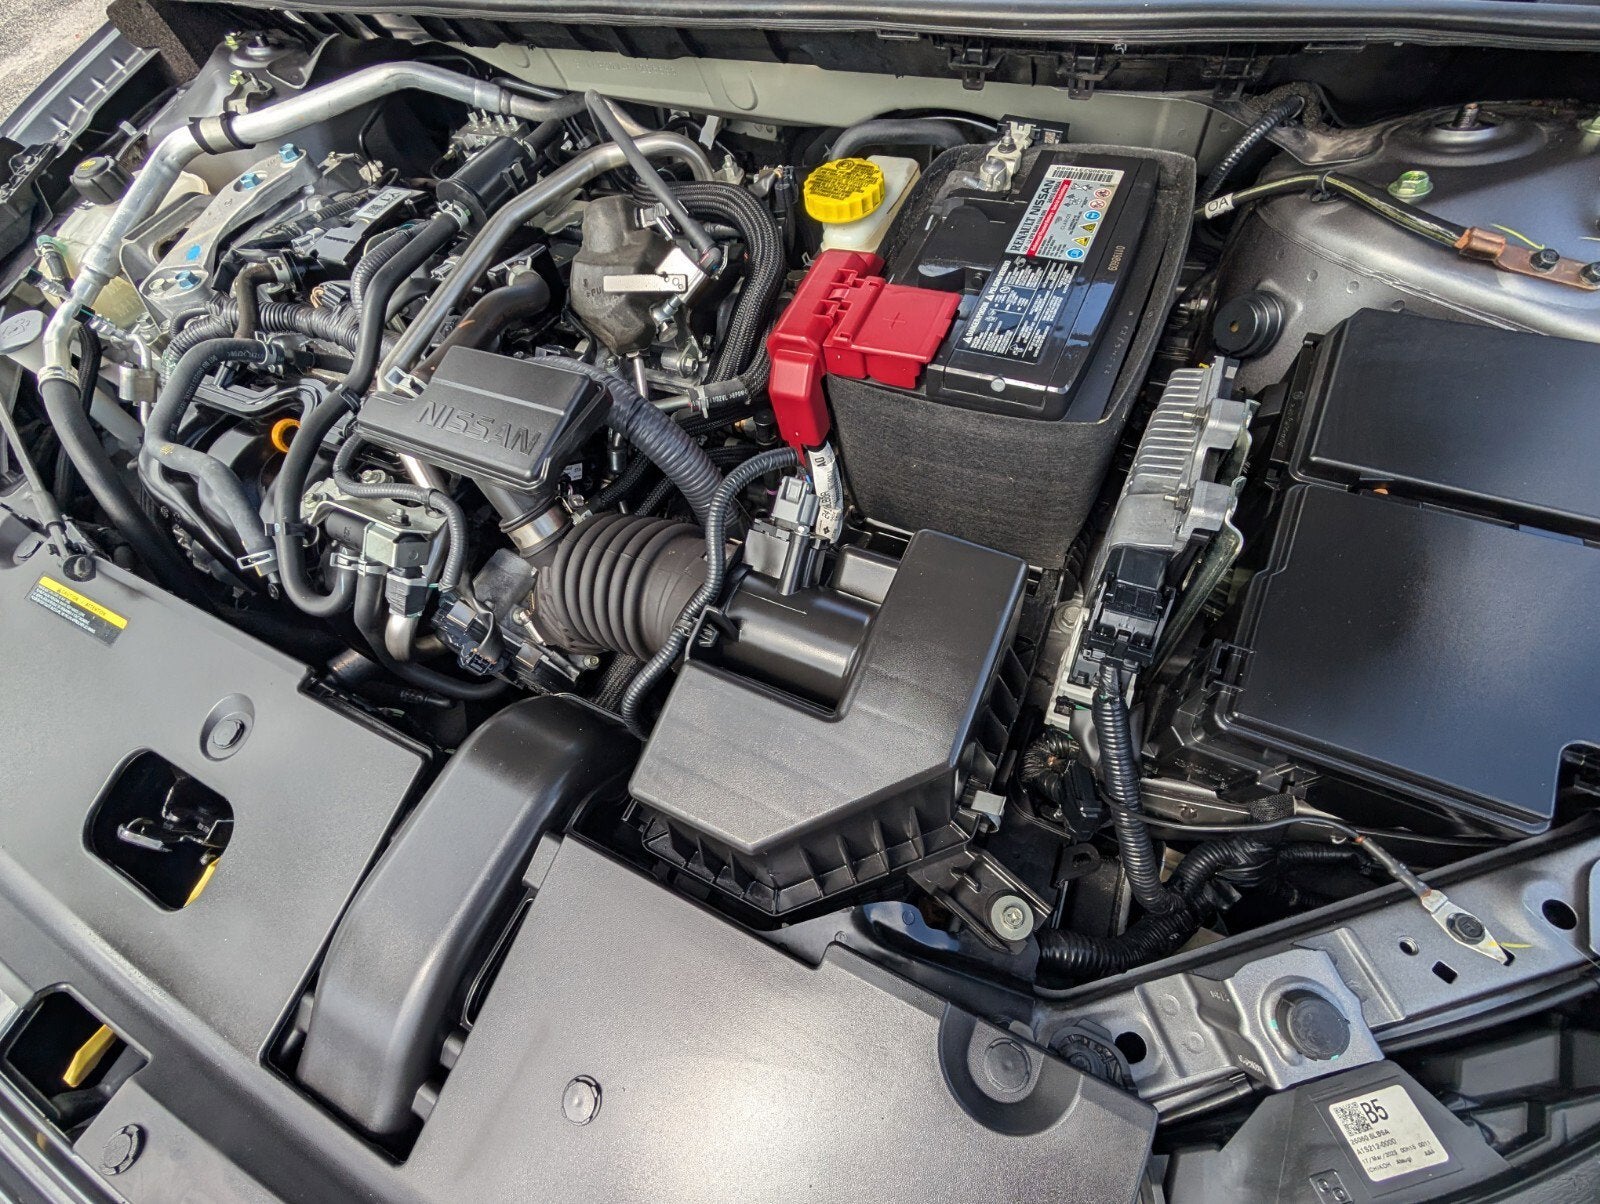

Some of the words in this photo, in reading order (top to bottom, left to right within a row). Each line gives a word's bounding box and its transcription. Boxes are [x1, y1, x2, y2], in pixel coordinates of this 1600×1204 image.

[1010, 217, 1035, 251] RENAULT
[1030, 180, 1056, 215] NISSAN
[416, 400, 542, 456] NISSAN
[1360, 1098, 1389, 1124] B5
